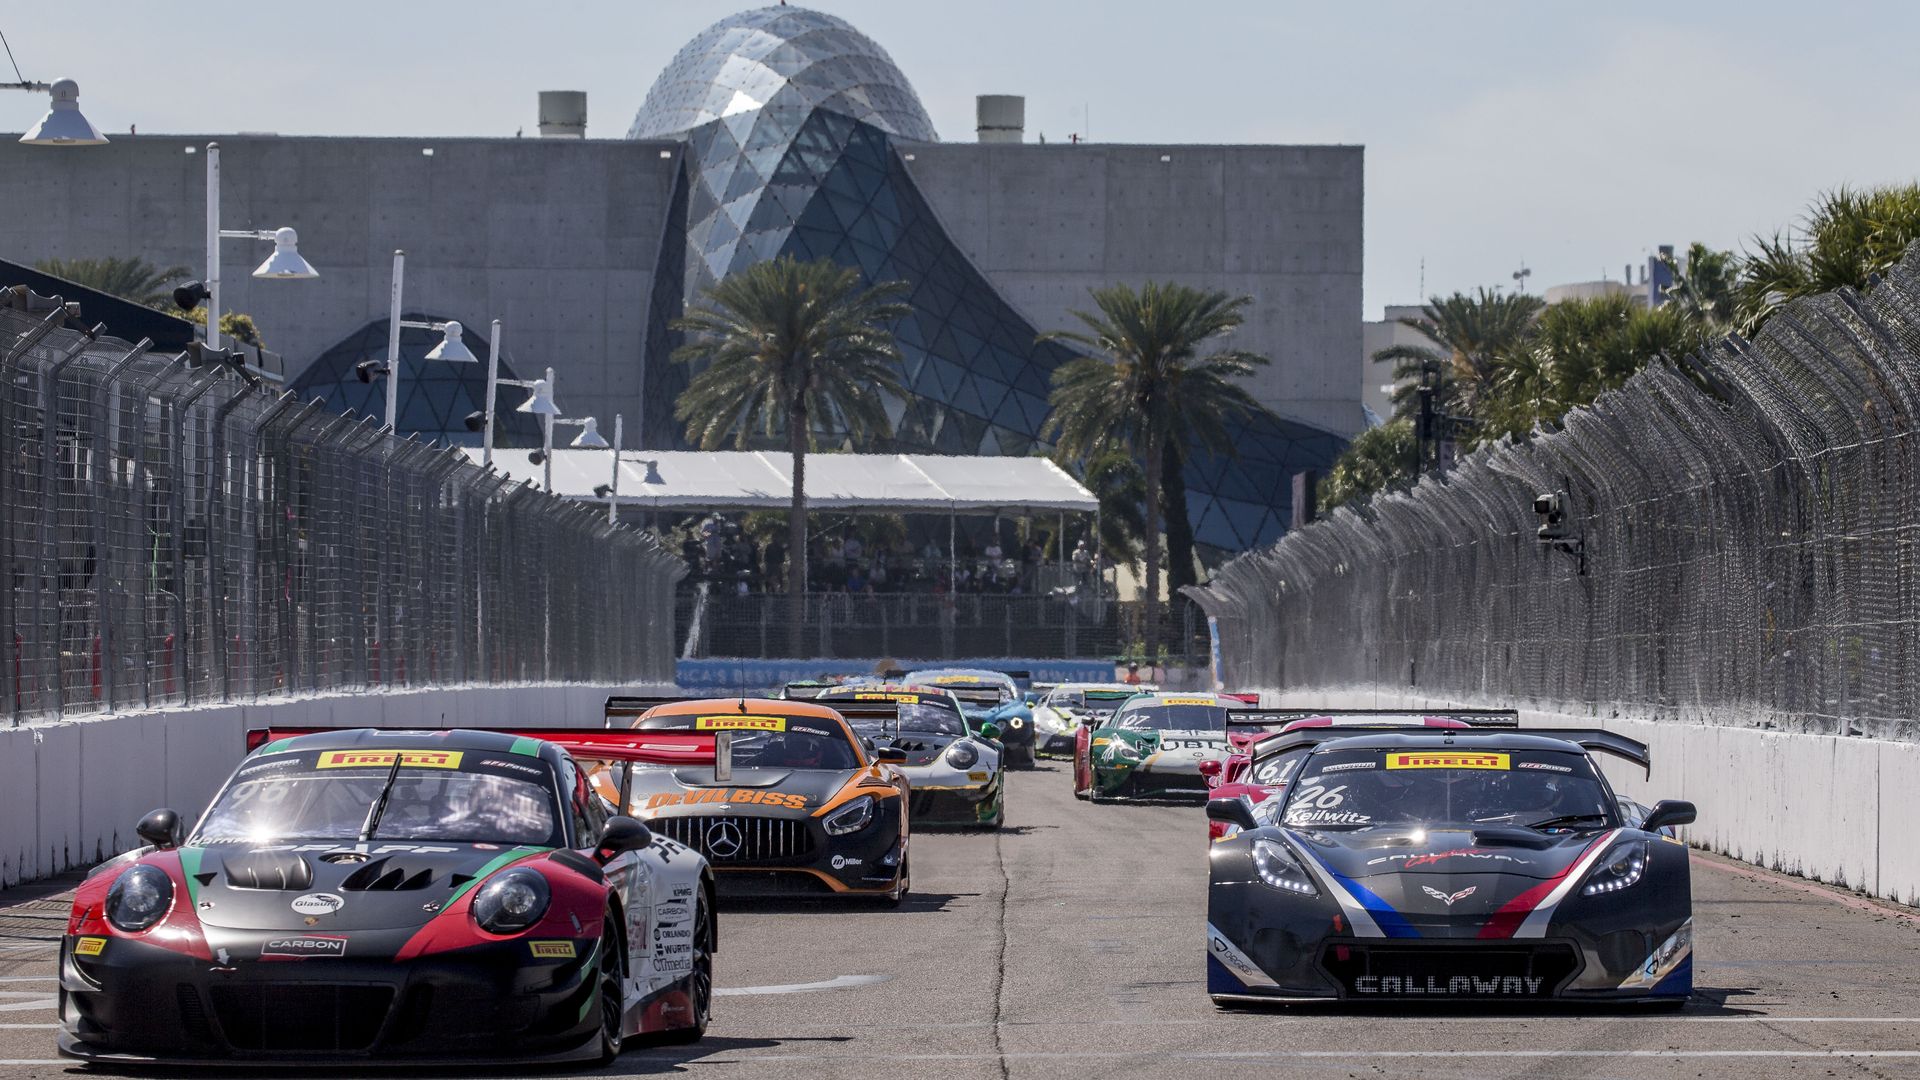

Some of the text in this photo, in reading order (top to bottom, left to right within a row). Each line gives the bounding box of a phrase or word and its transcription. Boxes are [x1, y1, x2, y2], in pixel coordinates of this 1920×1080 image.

[705, 718, 778, 728] PIRELLI
[1123, 714, 1151, 726] 07
[331, 752, 449, 765] PIRELLI
[1398, 755, 1500, 766] PIRELLI
[1258, 759, 1297, 780] 61
[229, 781, 290, 810] 96
[1291, 785, 1348, 809] 26
[1284, 809, 1372, 824] Keilwitz
[673, 887, 693, 897] KPMG
[657, 905, 688, 916] CARBON
[662, 929, 691, 939] ORLANDO
[78, 940, 103, 952] PIRELLI
[269, 940, 341, 950] CARBON
[535, 943, 573, 954] PIRELLI
[1355, 975, 1544, 994] CALLAWAY
